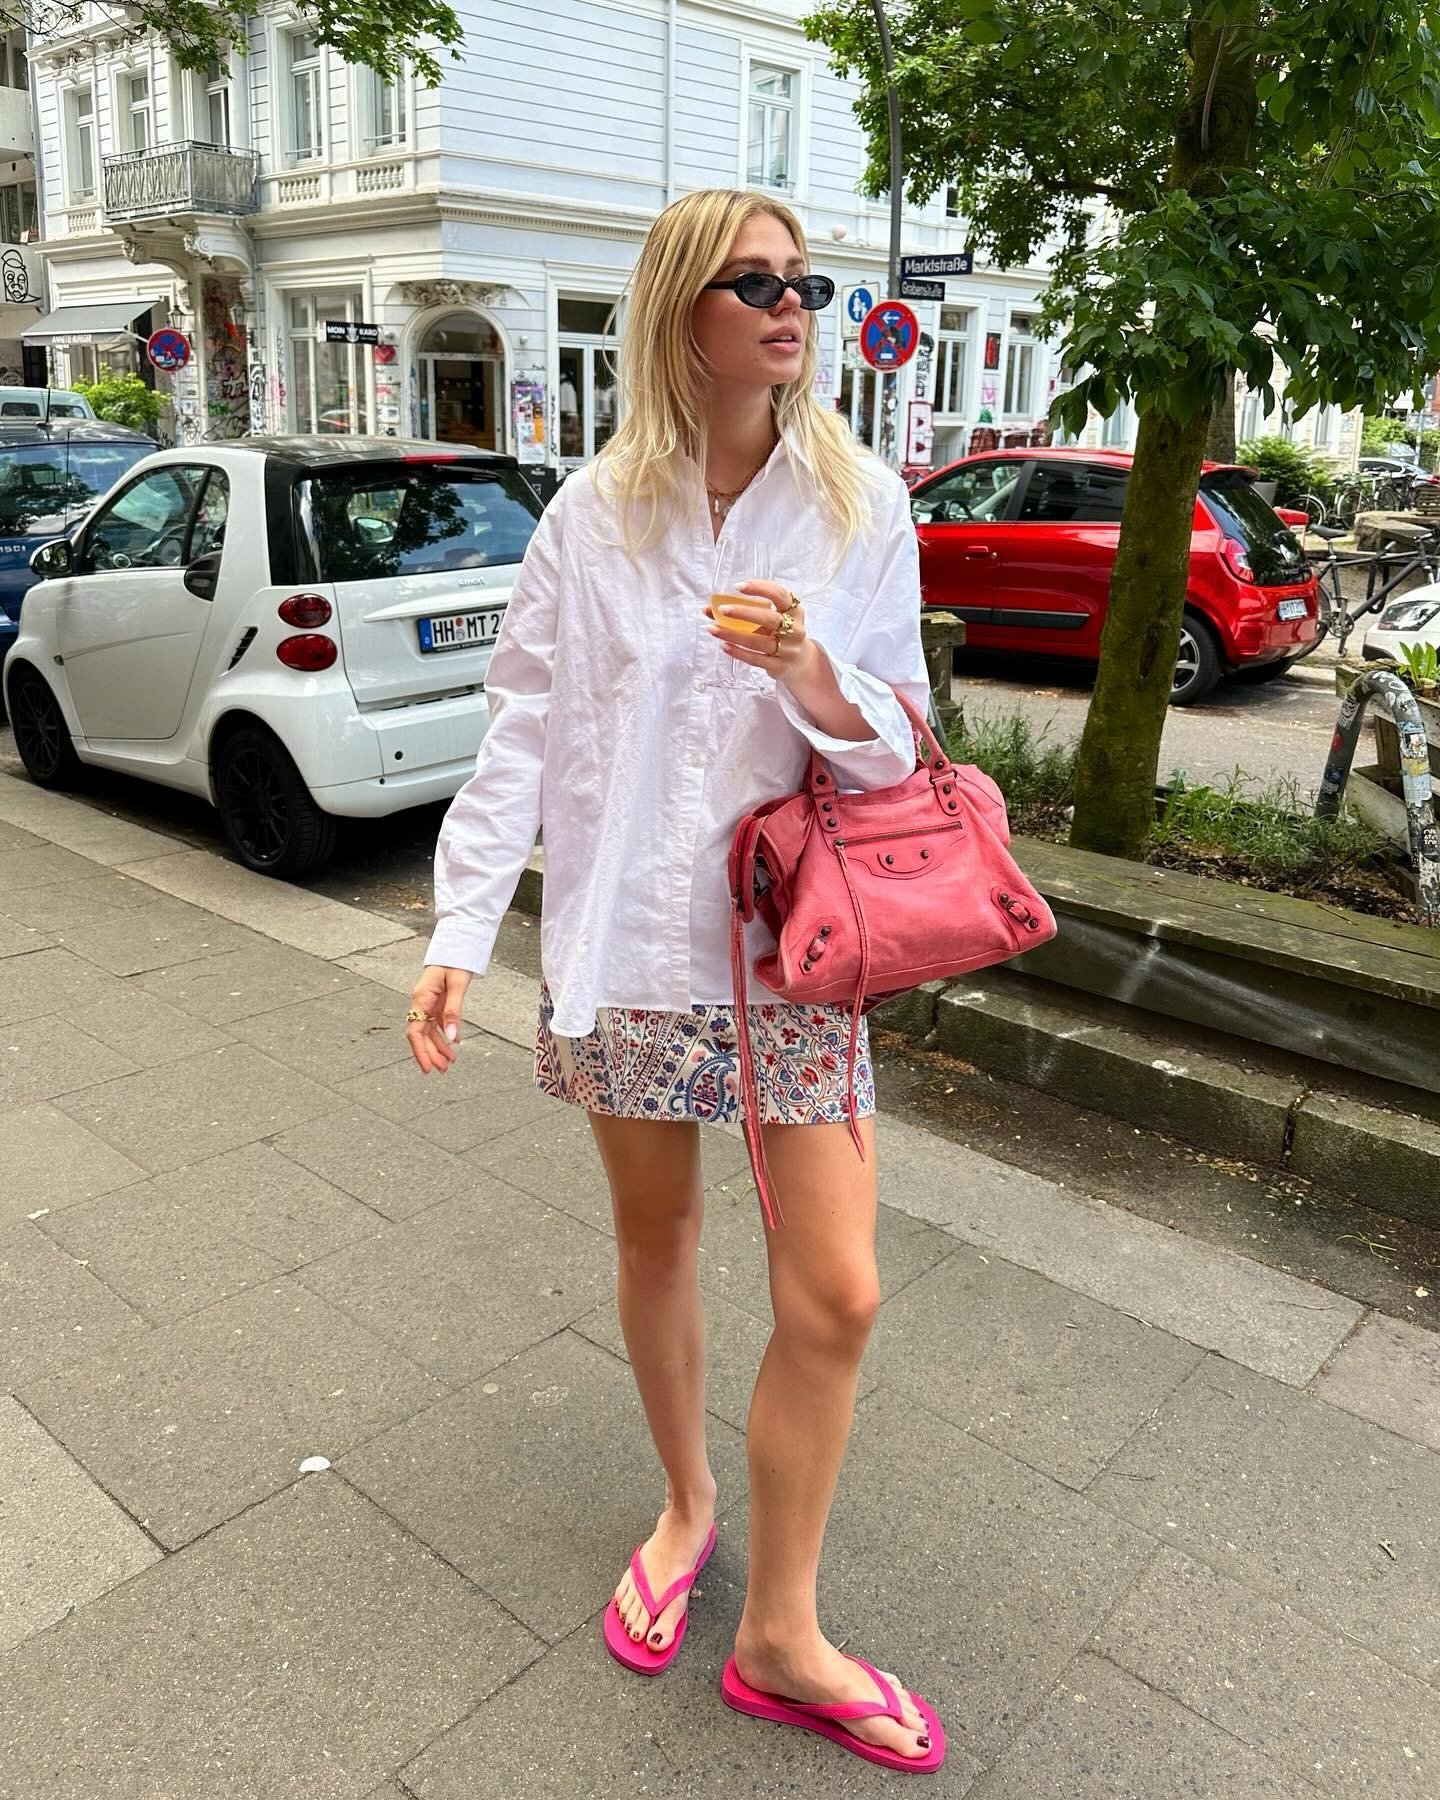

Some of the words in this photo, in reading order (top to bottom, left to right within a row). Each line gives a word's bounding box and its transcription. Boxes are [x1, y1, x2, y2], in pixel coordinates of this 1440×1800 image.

[904, 257, 968, 274] Marktstraße
[327, 326, 345, 334] MOIN
[359, 328, 378, 336] KARO
[458, 576, 485, 587] smart
[432, 619, 455, 643] HH
[466, 615, 486, 638] MT
[491, 613, 505, 635] 2
